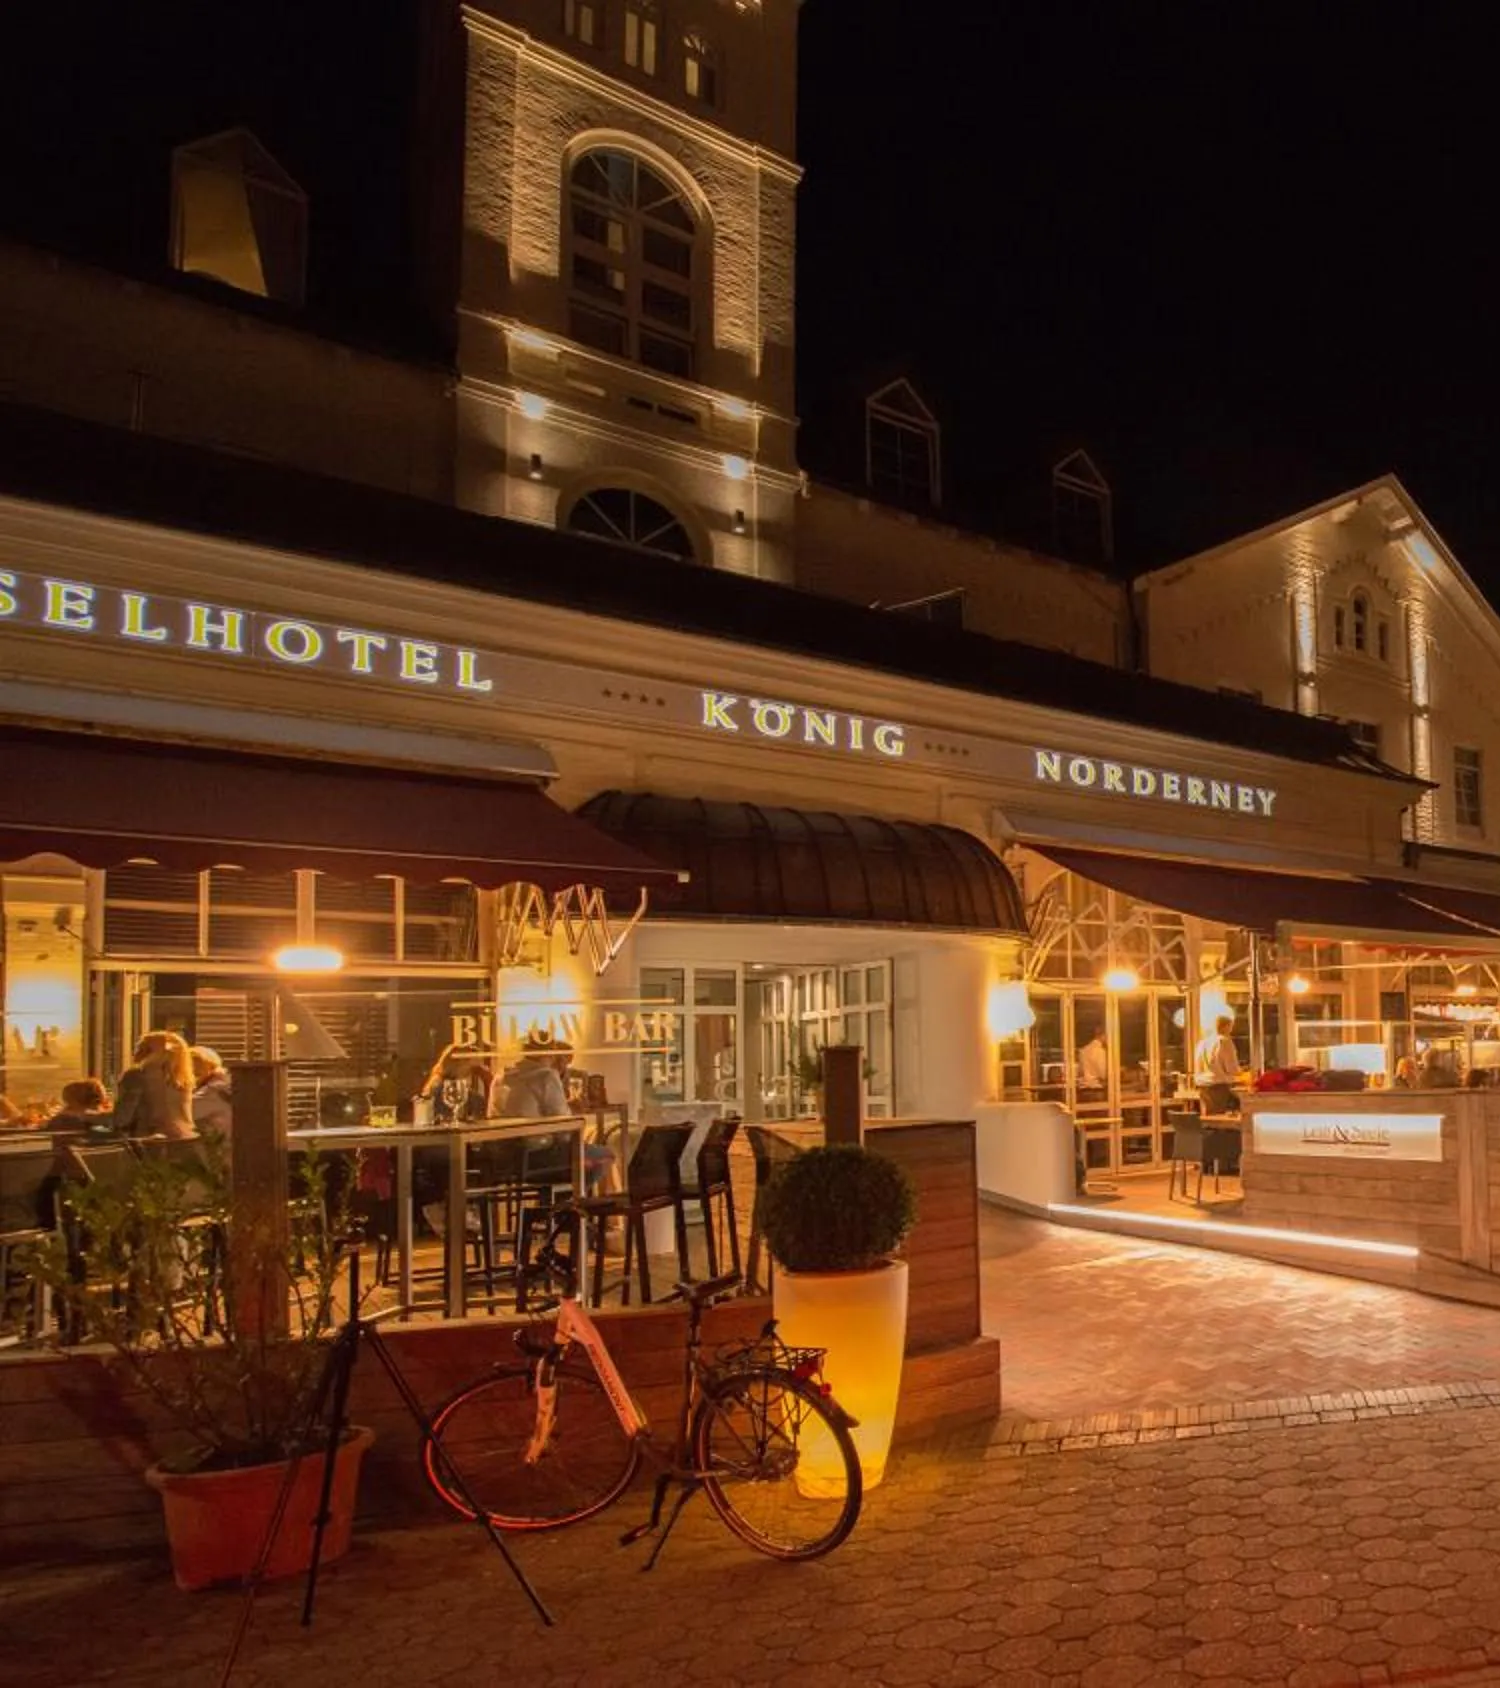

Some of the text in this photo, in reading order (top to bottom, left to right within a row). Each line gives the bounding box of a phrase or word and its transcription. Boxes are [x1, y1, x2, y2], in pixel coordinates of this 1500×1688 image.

[702, 692, 905, 756] KÖNIG
[1035, 751, 1277, 817] NORDERNEY
[604, 1010, 676, 1042] BAR
